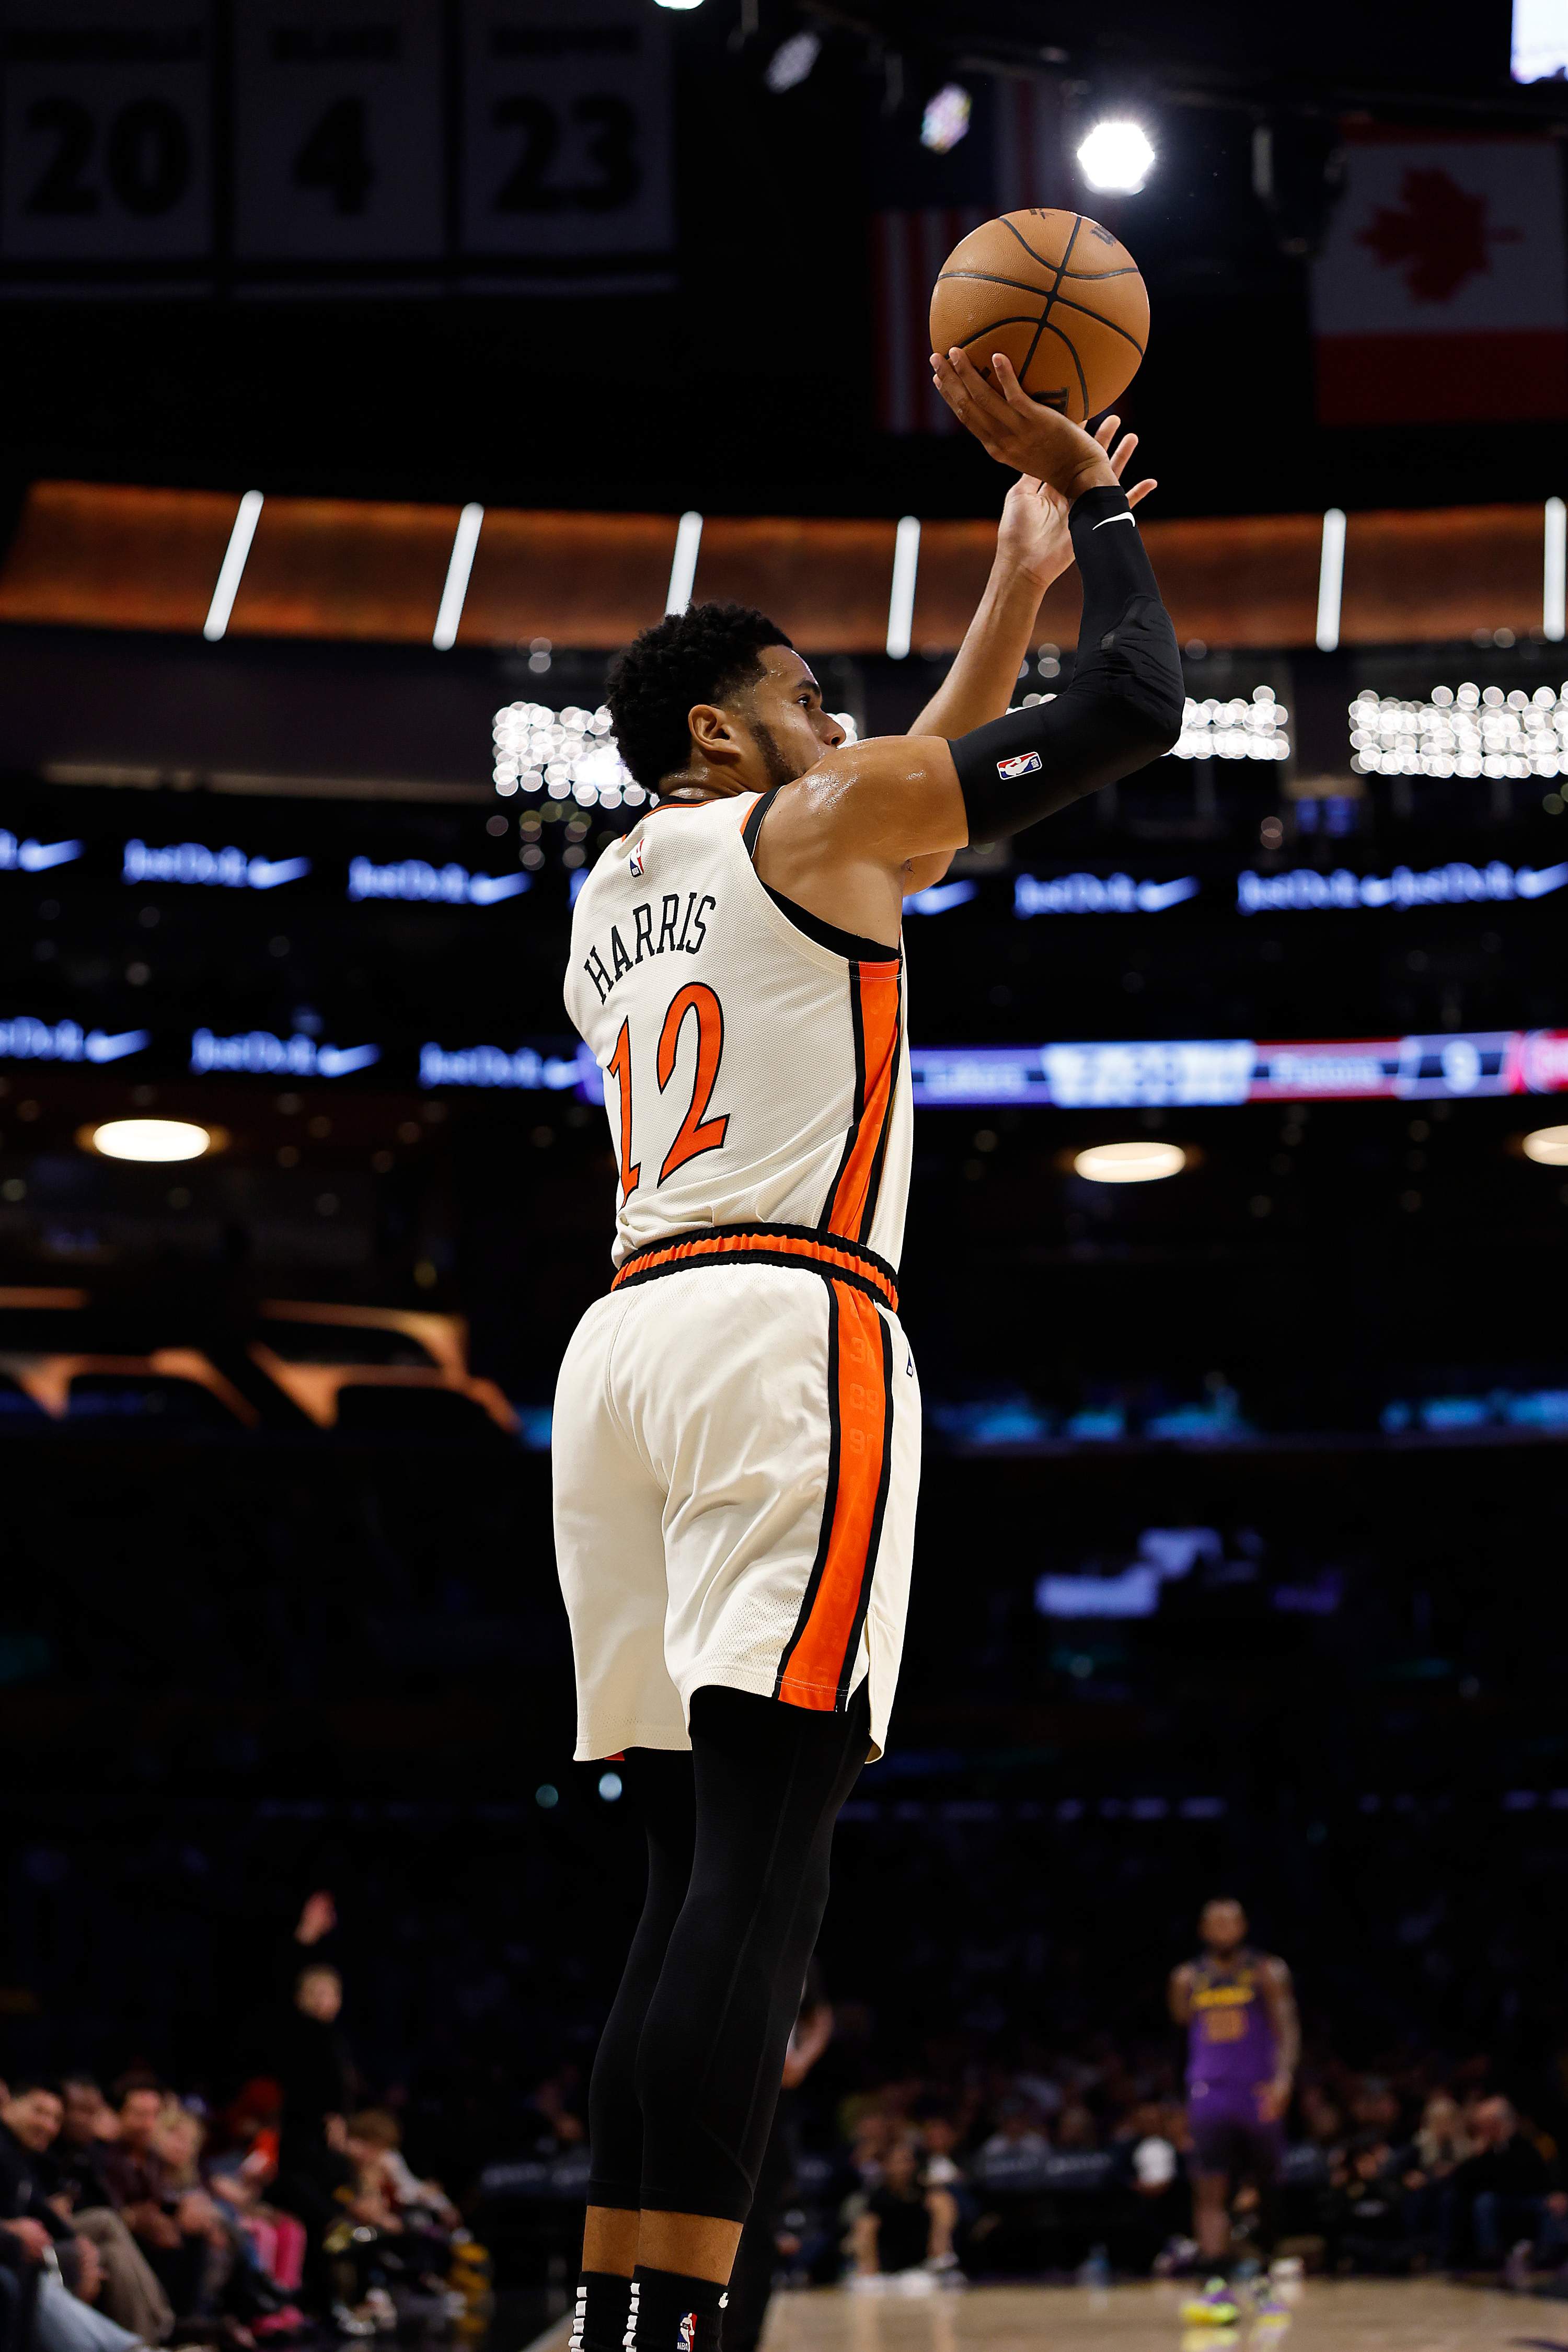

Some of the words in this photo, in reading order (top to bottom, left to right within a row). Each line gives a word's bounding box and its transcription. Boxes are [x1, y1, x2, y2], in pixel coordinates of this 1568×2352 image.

[23, 96, 189, 216] 20
[293, 96, 375, 216] 4
[490, 94, 642, 214] 23
[584, 892, 716, 1006] HARRIS
[607, 981, 731, 1209] 12
[677, 2342, 688, 2350] NBA
